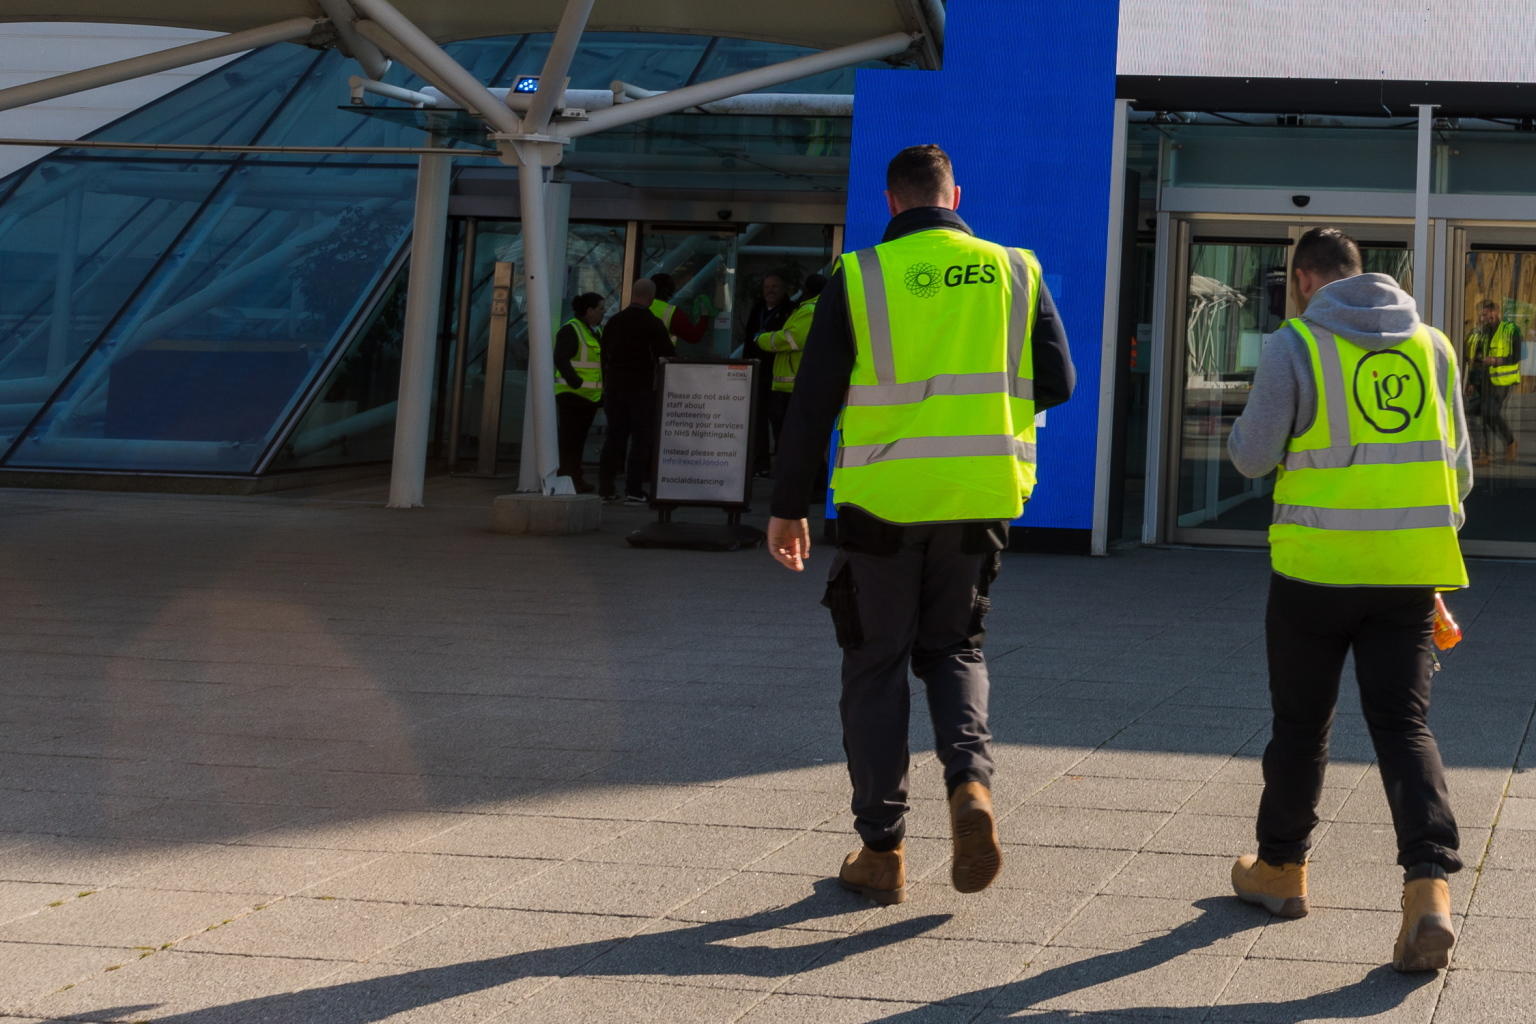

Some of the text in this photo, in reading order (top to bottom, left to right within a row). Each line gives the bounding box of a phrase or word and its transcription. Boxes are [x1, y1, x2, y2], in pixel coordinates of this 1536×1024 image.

[943, 264, 996, 287] GES
[667, 391, 690, 400] Please
[718, 393, 730, 401] ask
[666, 411, 711, 420] volunteering
[665, 420, 693, 429] offering
[714, 422, 744, 430] services
[716, 449, 737, 457] email
